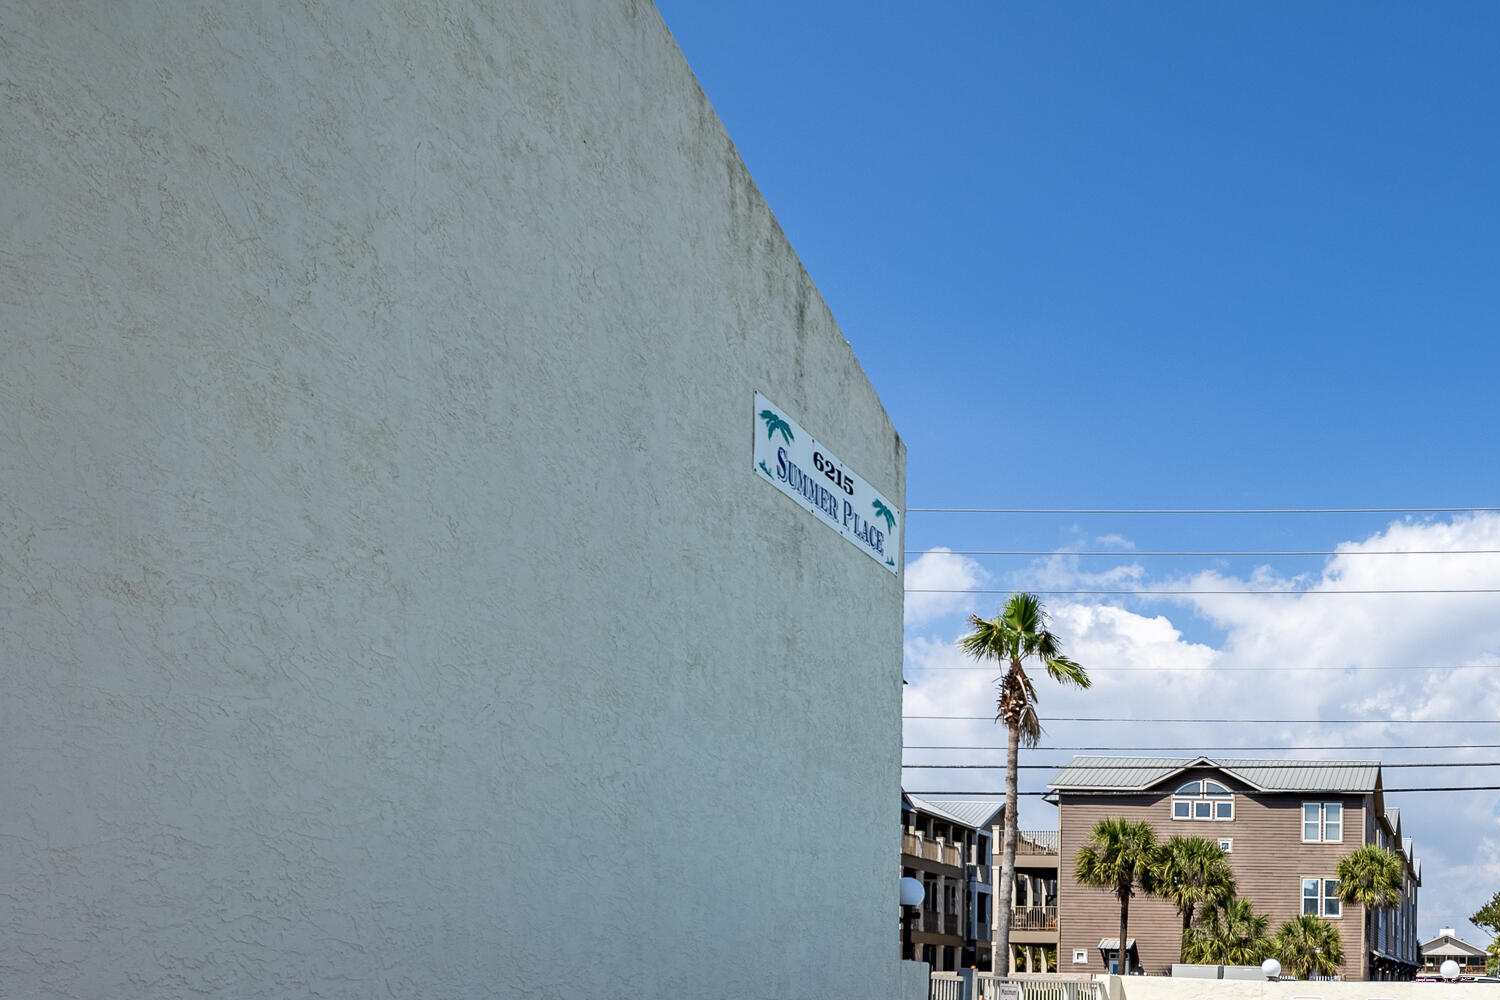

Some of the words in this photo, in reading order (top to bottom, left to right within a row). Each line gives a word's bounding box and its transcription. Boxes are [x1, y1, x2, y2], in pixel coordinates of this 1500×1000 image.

[776, 447, 839, 523] SUMMER
[843, 497, 885, 556] PLACE
[813, 451, 854, 495] 6215
